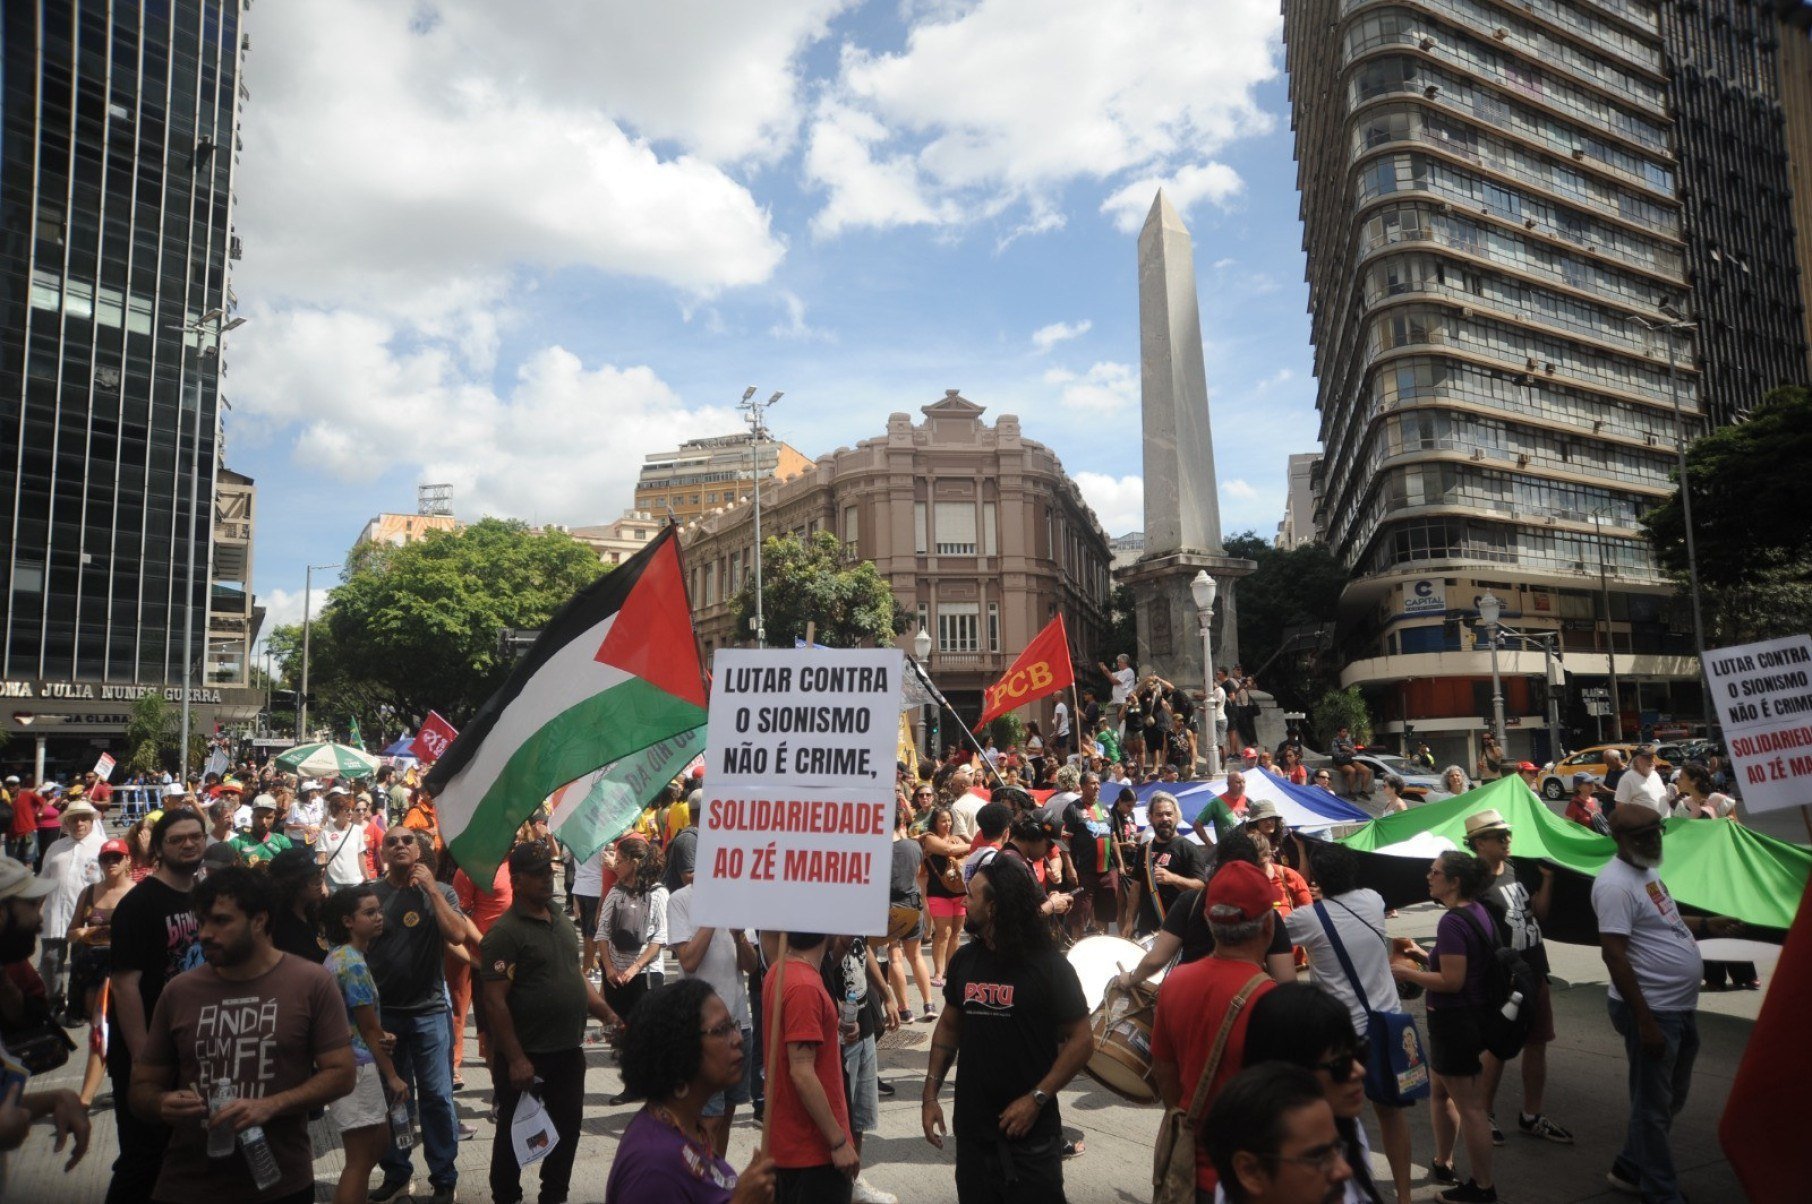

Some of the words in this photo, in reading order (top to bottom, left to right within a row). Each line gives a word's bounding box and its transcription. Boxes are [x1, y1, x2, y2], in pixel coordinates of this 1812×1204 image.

[1405, 596, 1445, 607] CAPITAL
[1712, 655, 1755, 677] LUTAR
[1757, 646, 1811, 669] CONTRA
[101, 686, 157, 699] NUNES
[724, 667, 792, 693] LUTAR
[800, 667, 888, 693] CONTRA
[992, 662, 1053, 710] PCB
[1728, 682, 1739, 698] O
[1741, 670, 1808, 697] SIONISMO
[86, 715, 128, 723] CLARA
[735, 707, 750, 733] O
[757, 706, 870, 733] SIONISMO
[1728, 702, 1758, 723] NÃO
[1761, 698, 1772, 718] É
[1732, 725, 1812, 758] SOLIDARIED
[723, 741, 767, 774] NÃO
[775, 741, 787, 774] É
[795, 747, 877, 778] CRIME,
[1746, 764, 1767, 785] AO
[1768, 756, 1787, 780] ZÉ
[708, 799, 885, 835] SOLIDARIEDADE
[713, 847, 744, 879] AO
[750, 841, 776, 880] ZÉ
[783, 849, 872, 884] MARIA!
[965, 982, 1015, 1006] PSTU
[196, 998, 278, 1037] ANDÁ
[233, 1033, 277, 1080] FÉ
